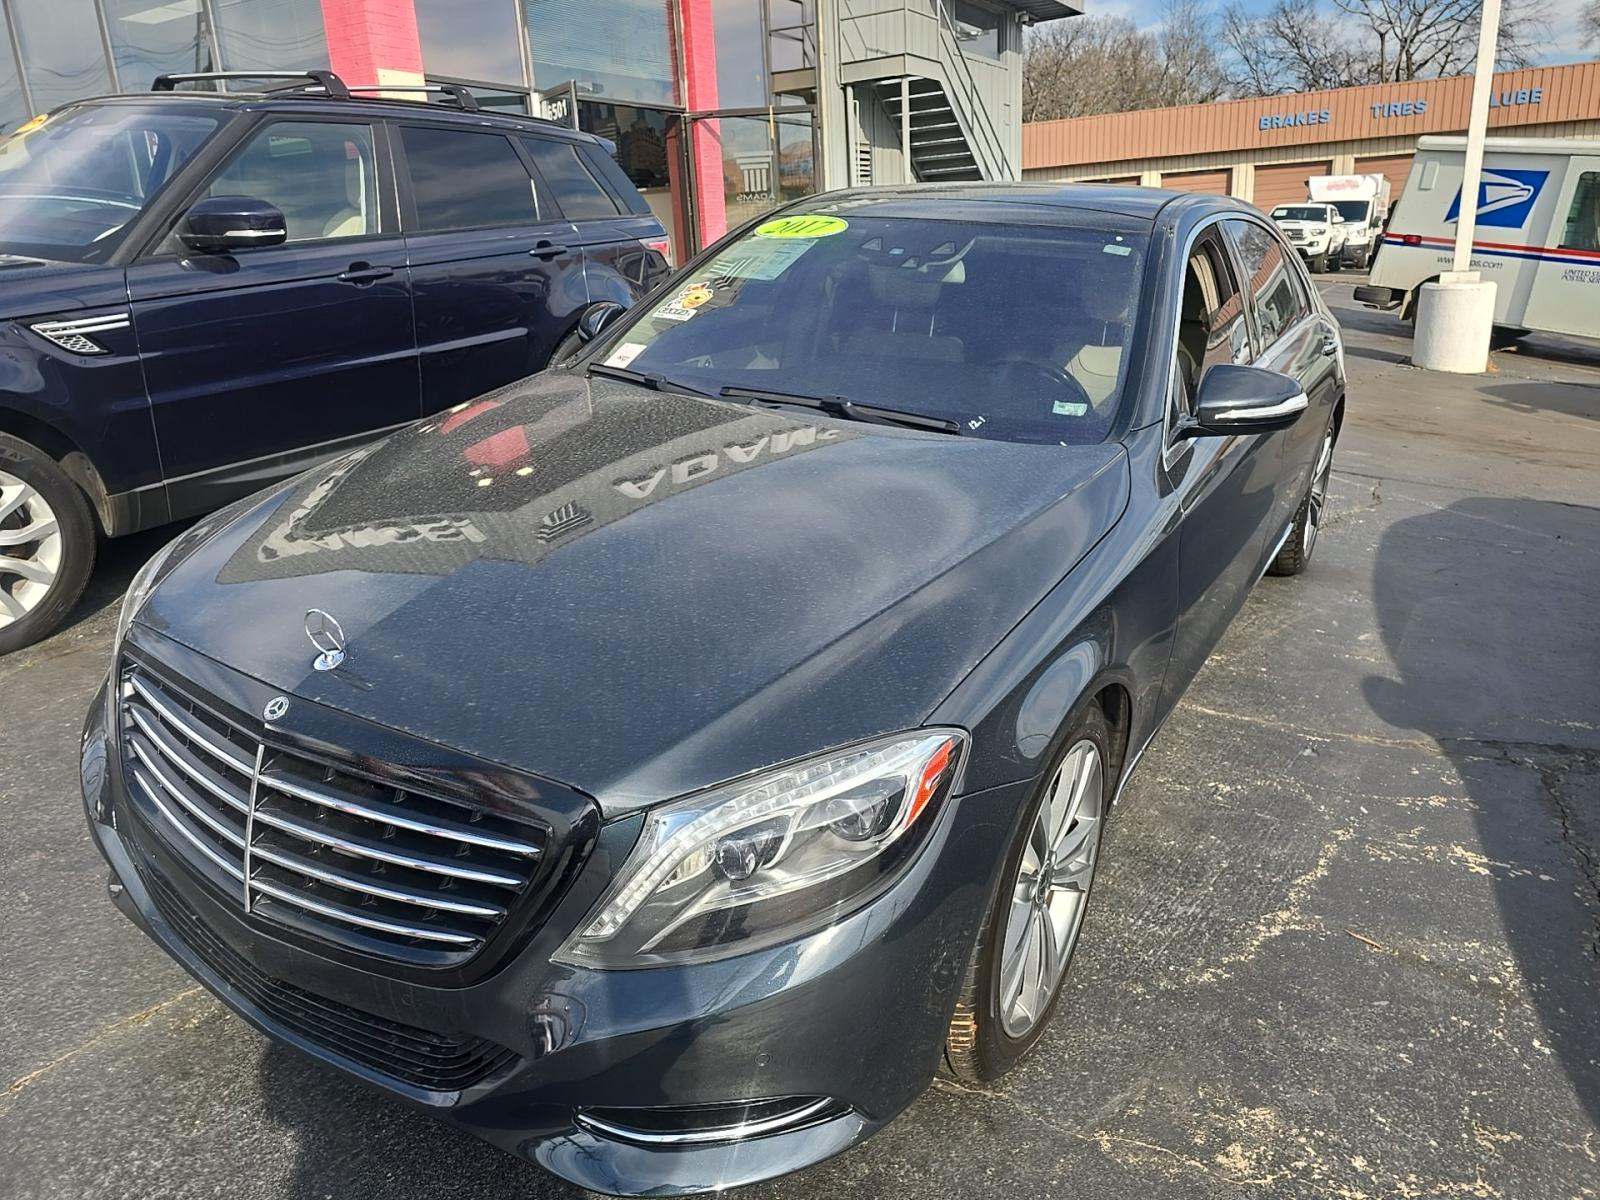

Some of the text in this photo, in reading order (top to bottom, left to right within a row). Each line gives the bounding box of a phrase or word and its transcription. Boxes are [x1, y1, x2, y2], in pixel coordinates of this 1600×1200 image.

[1259, 109, 1331, 131] BRAKES
[1370, 100, 1428, 119] TIRES
[763, 220, 837, 234] 2017
